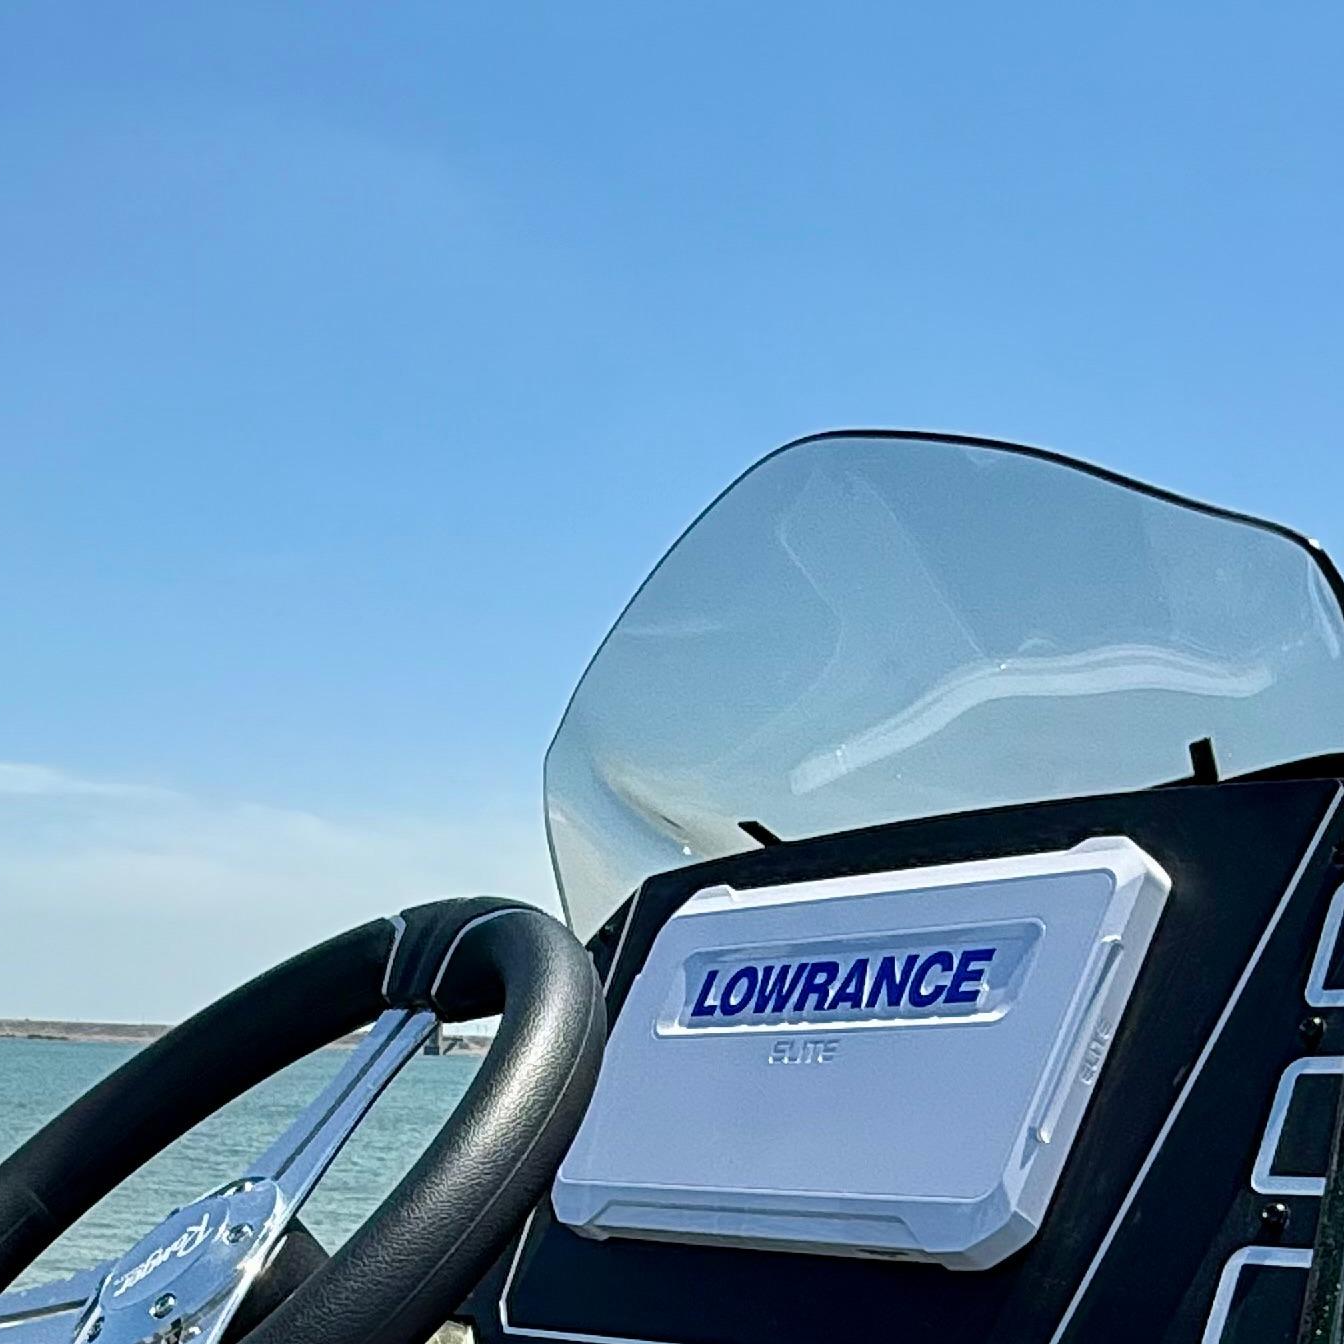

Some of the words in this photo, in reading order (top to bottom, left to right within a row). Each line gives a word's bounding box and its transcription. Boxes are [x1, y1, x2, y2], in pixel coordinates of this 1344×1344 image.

[691, 948, 997, 1017] LOWRANCE
[768, 1038, 843, 1065] ELITE
[113, 1212, 213, 1298] Ranger
